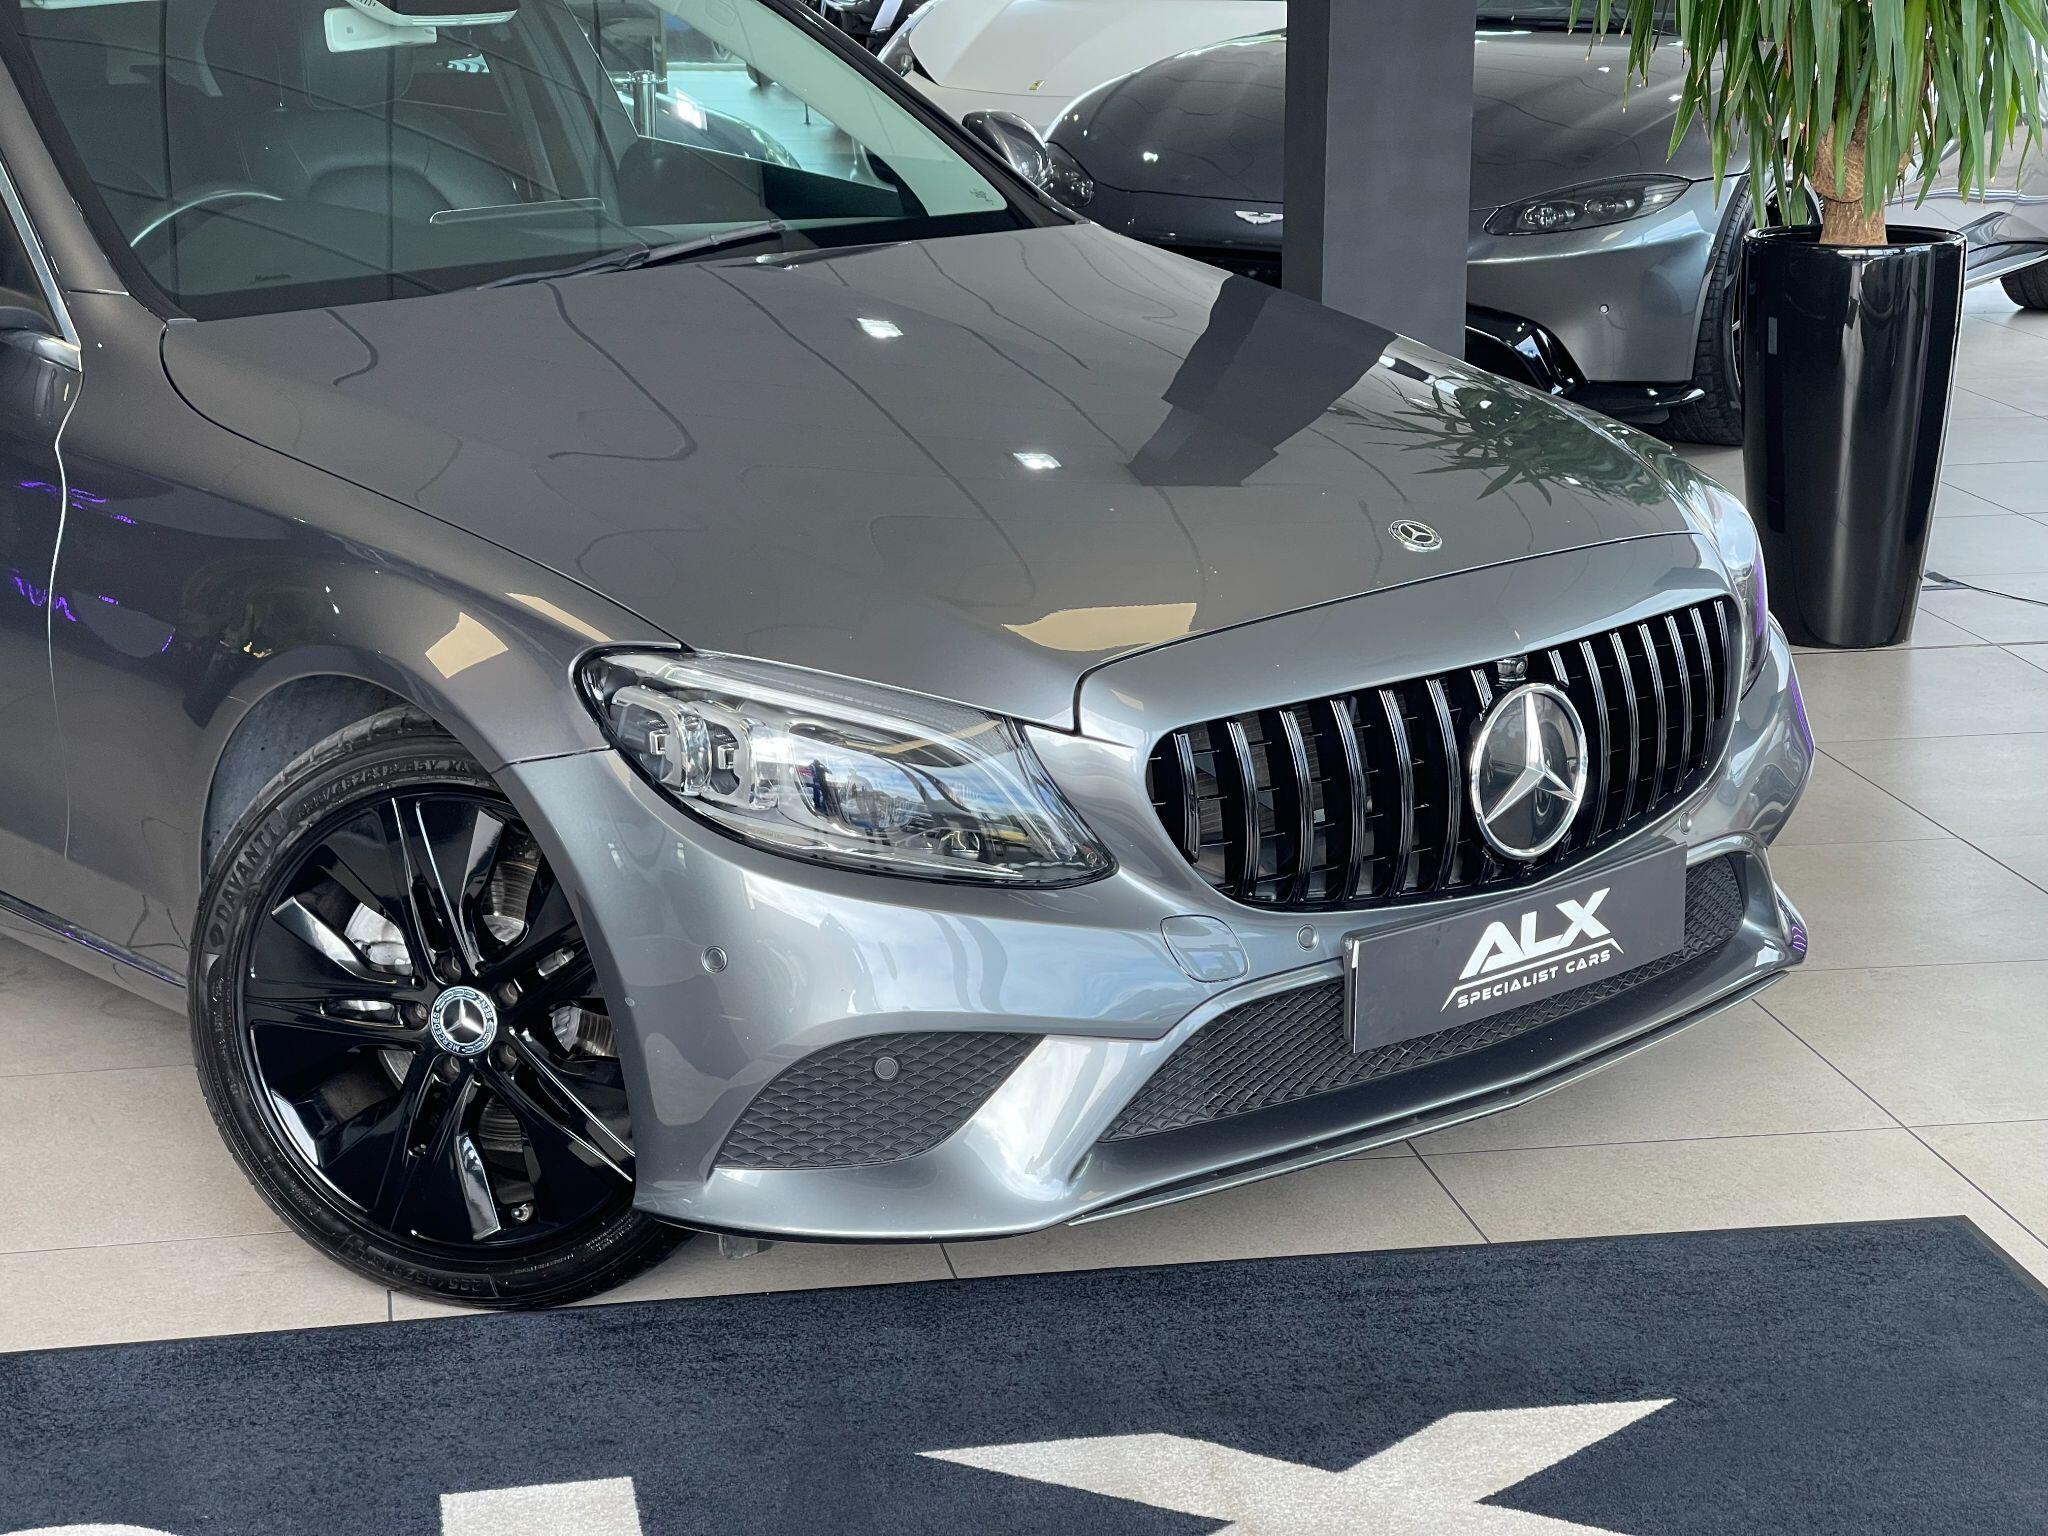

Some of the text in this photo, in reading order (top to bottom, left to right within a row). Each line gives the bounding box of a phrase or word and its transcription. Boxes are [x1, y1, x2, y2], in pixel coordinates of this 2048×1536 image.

[214, 820, 281, 924] DAVANTI
[1458, 887, 1611, 981] ALX
[1457, 949, 1611, 1009] SPECIALIST CARS
[432, 995, 494, 1053] MERCEDES BENZ
